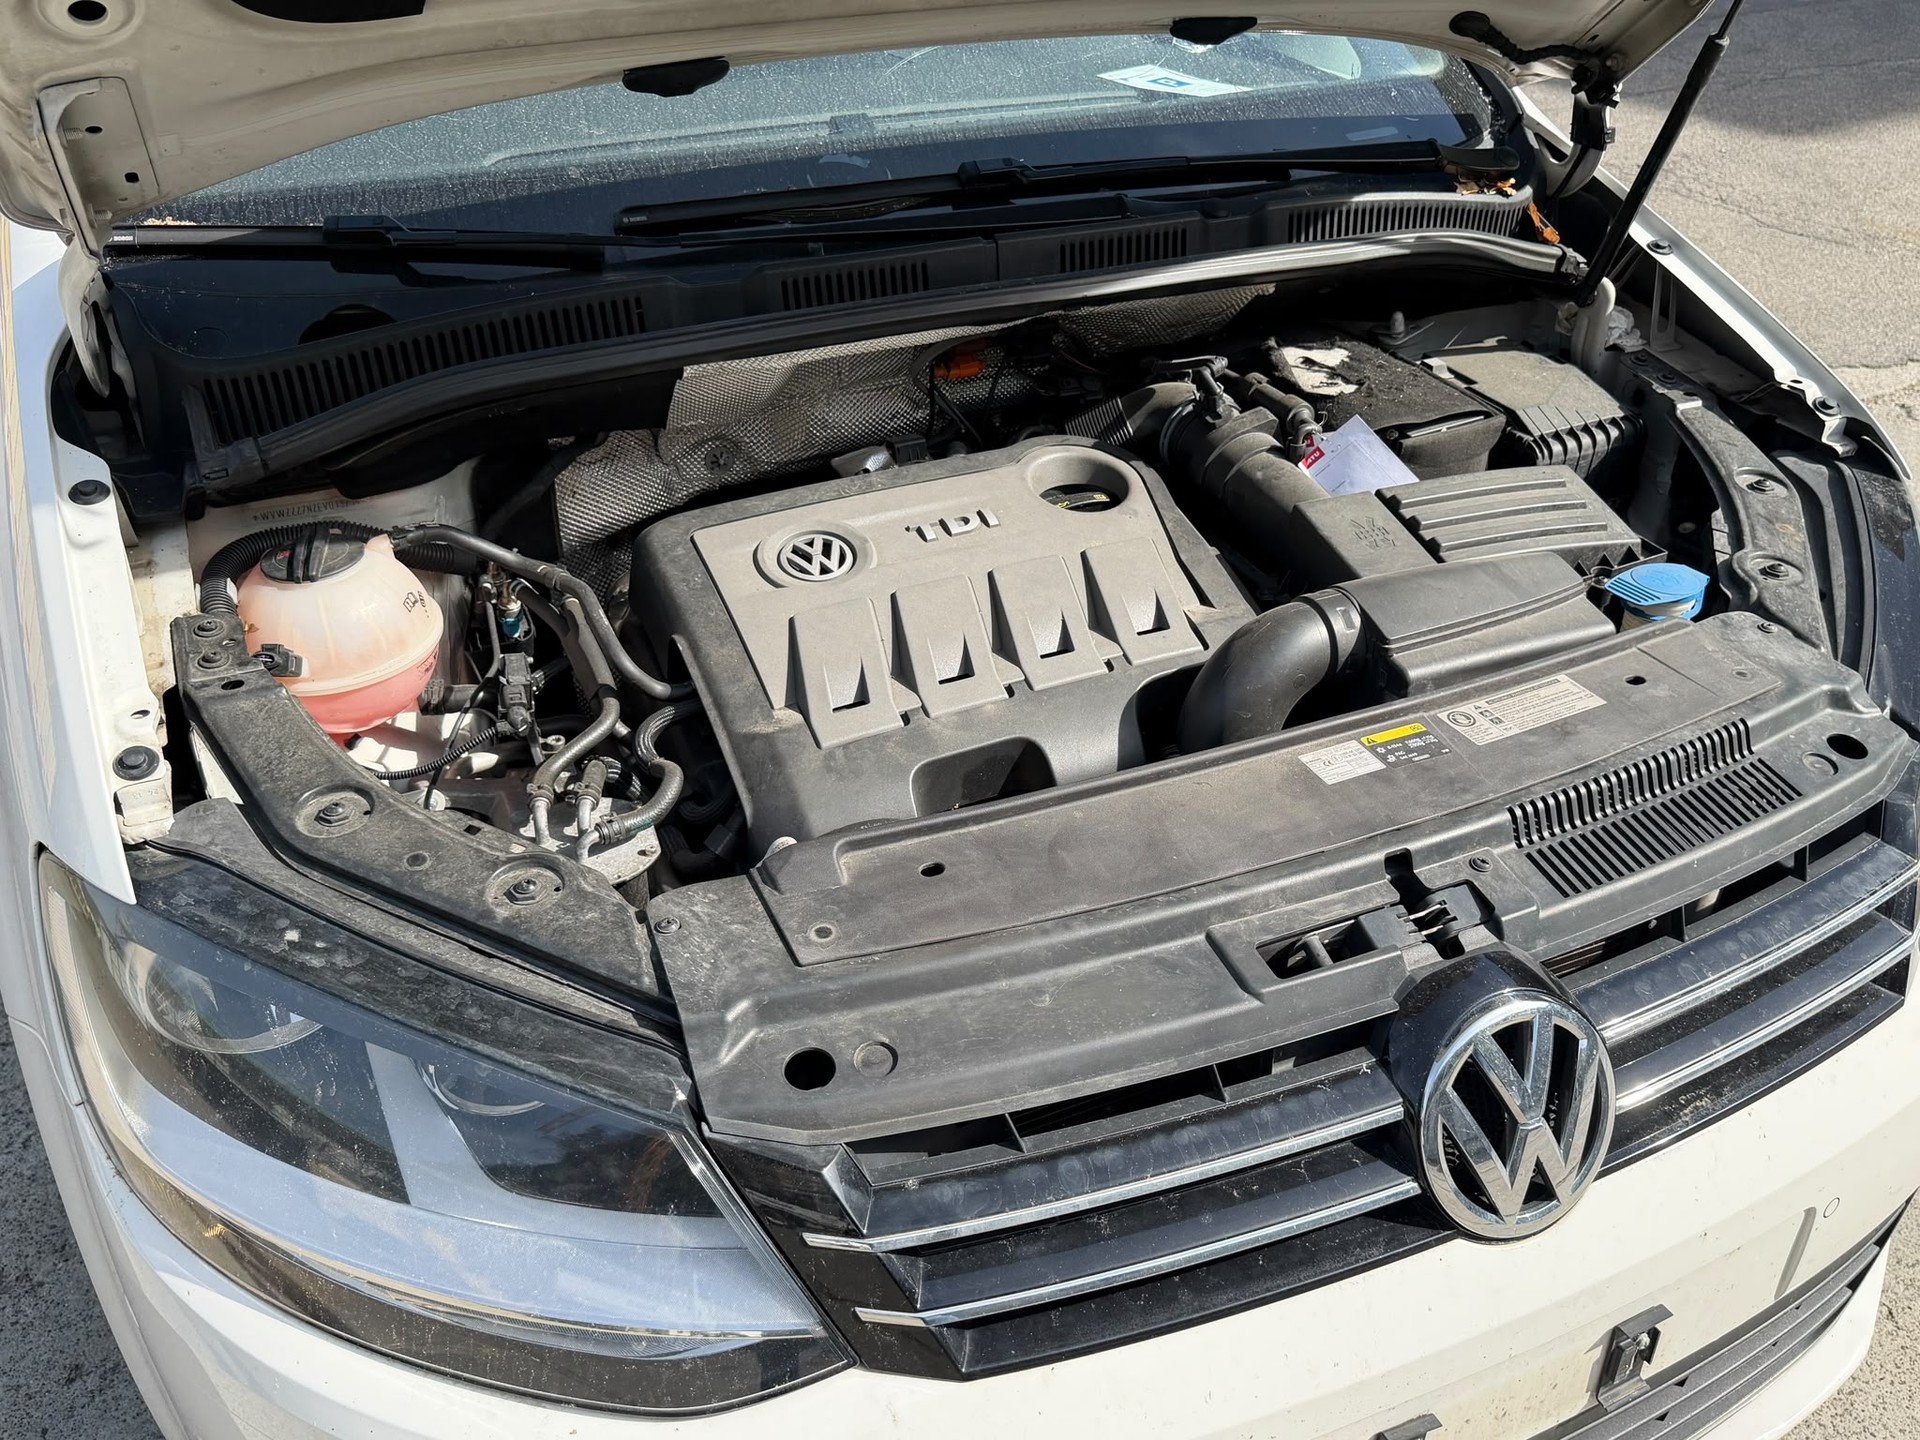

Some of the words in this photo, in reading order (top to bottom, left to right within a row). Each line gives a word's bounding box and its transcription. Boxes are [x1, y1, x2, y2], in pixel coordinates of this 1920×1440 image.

[1306, 450, 1320, 465] ATU
[904, 508, 1001, 543] TDI
[779, 533, 855, 582] VW
[1421, 990, 1616, 1239] VW
